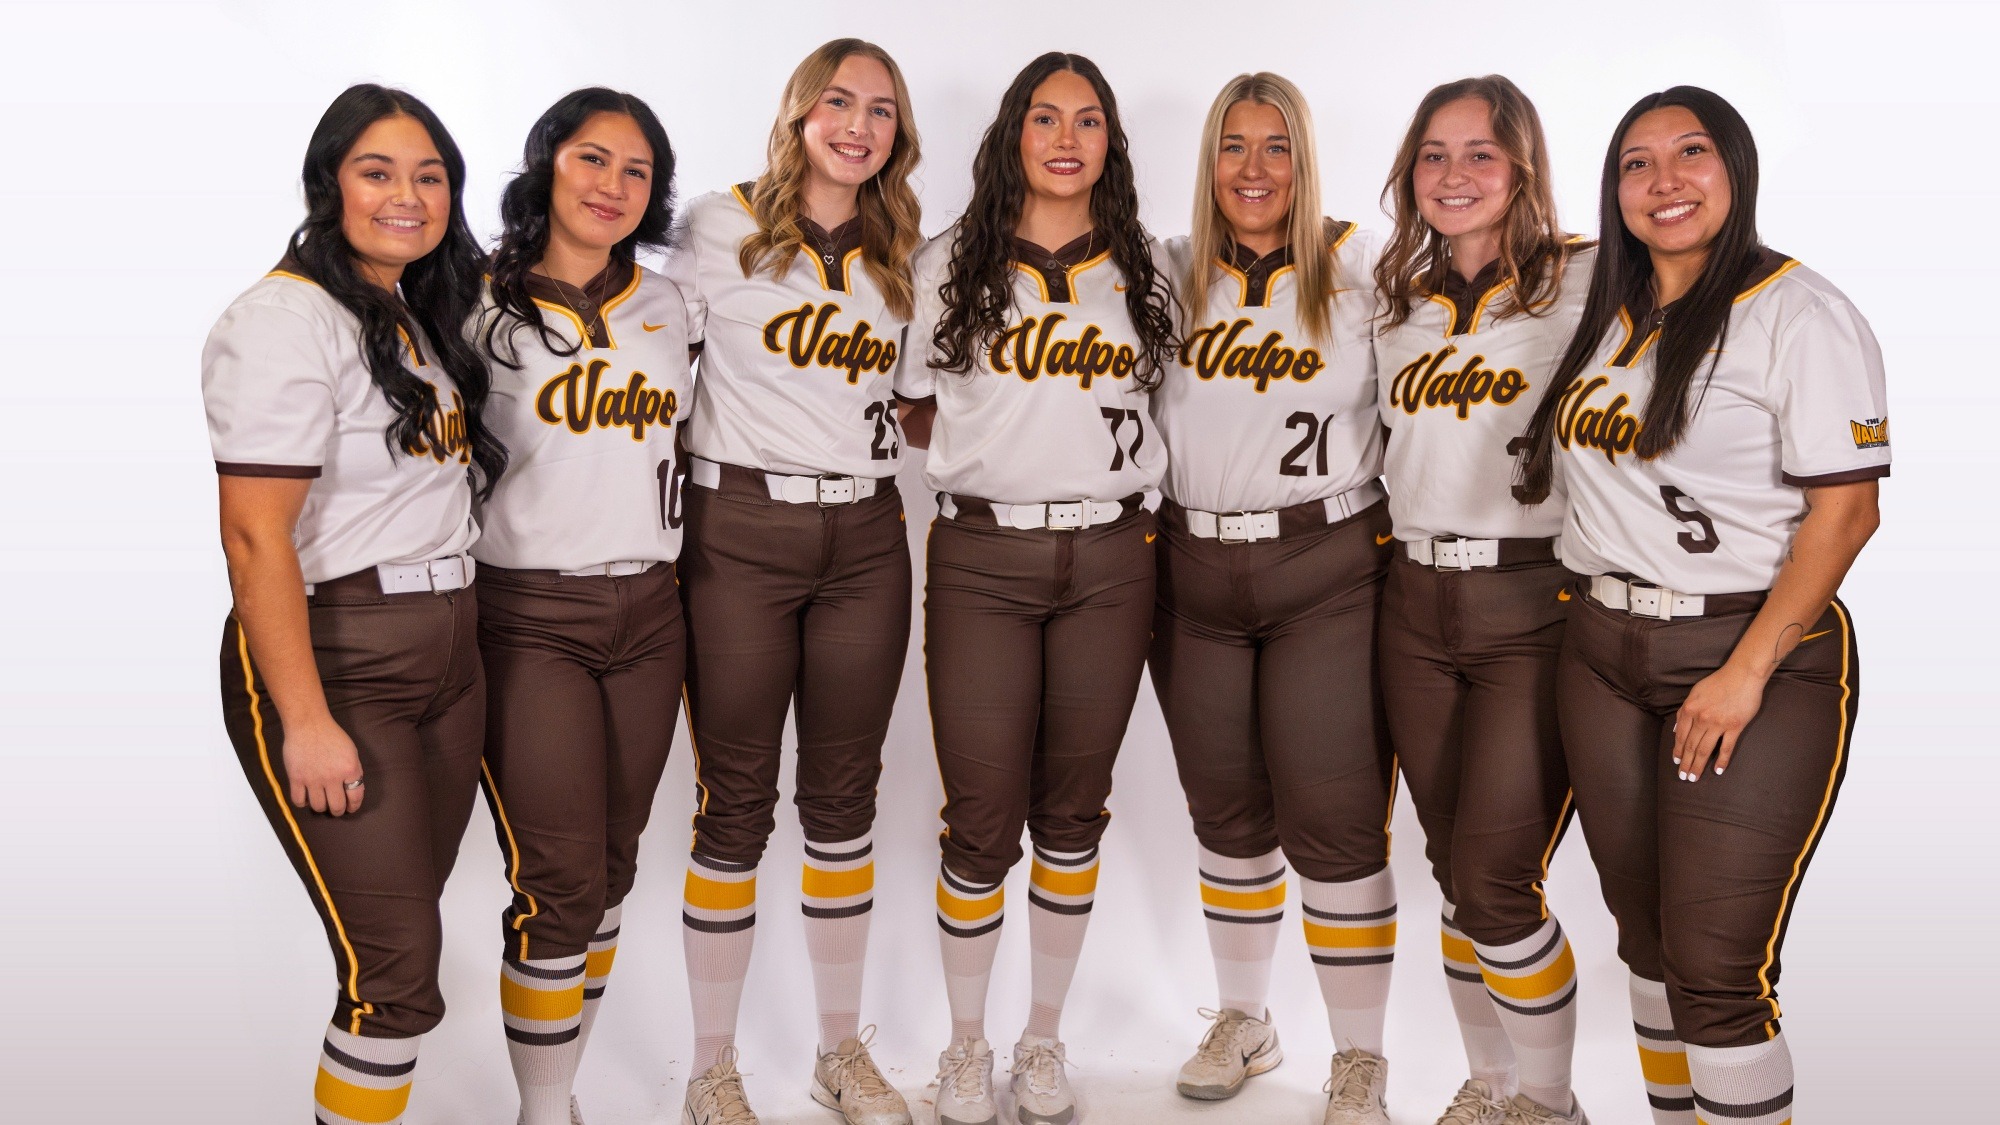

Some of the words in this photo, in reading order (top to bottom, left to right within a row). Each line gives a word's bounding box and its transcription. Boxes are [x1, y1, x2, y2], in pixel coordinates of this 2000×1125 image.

[763, 301, 897, 385] Valpo
[989, 312, 1136, 391] Valpo
[1179, 318, 1326, 394] Valpo
[535, 358, 678, 442] Valpo
[1390, 344, 1531, 421] Valpo
[1100, 406, 1144, 471] 77
[1279, 411, 1335, 476] 21
[1659, 485, 1721, 554] 5
